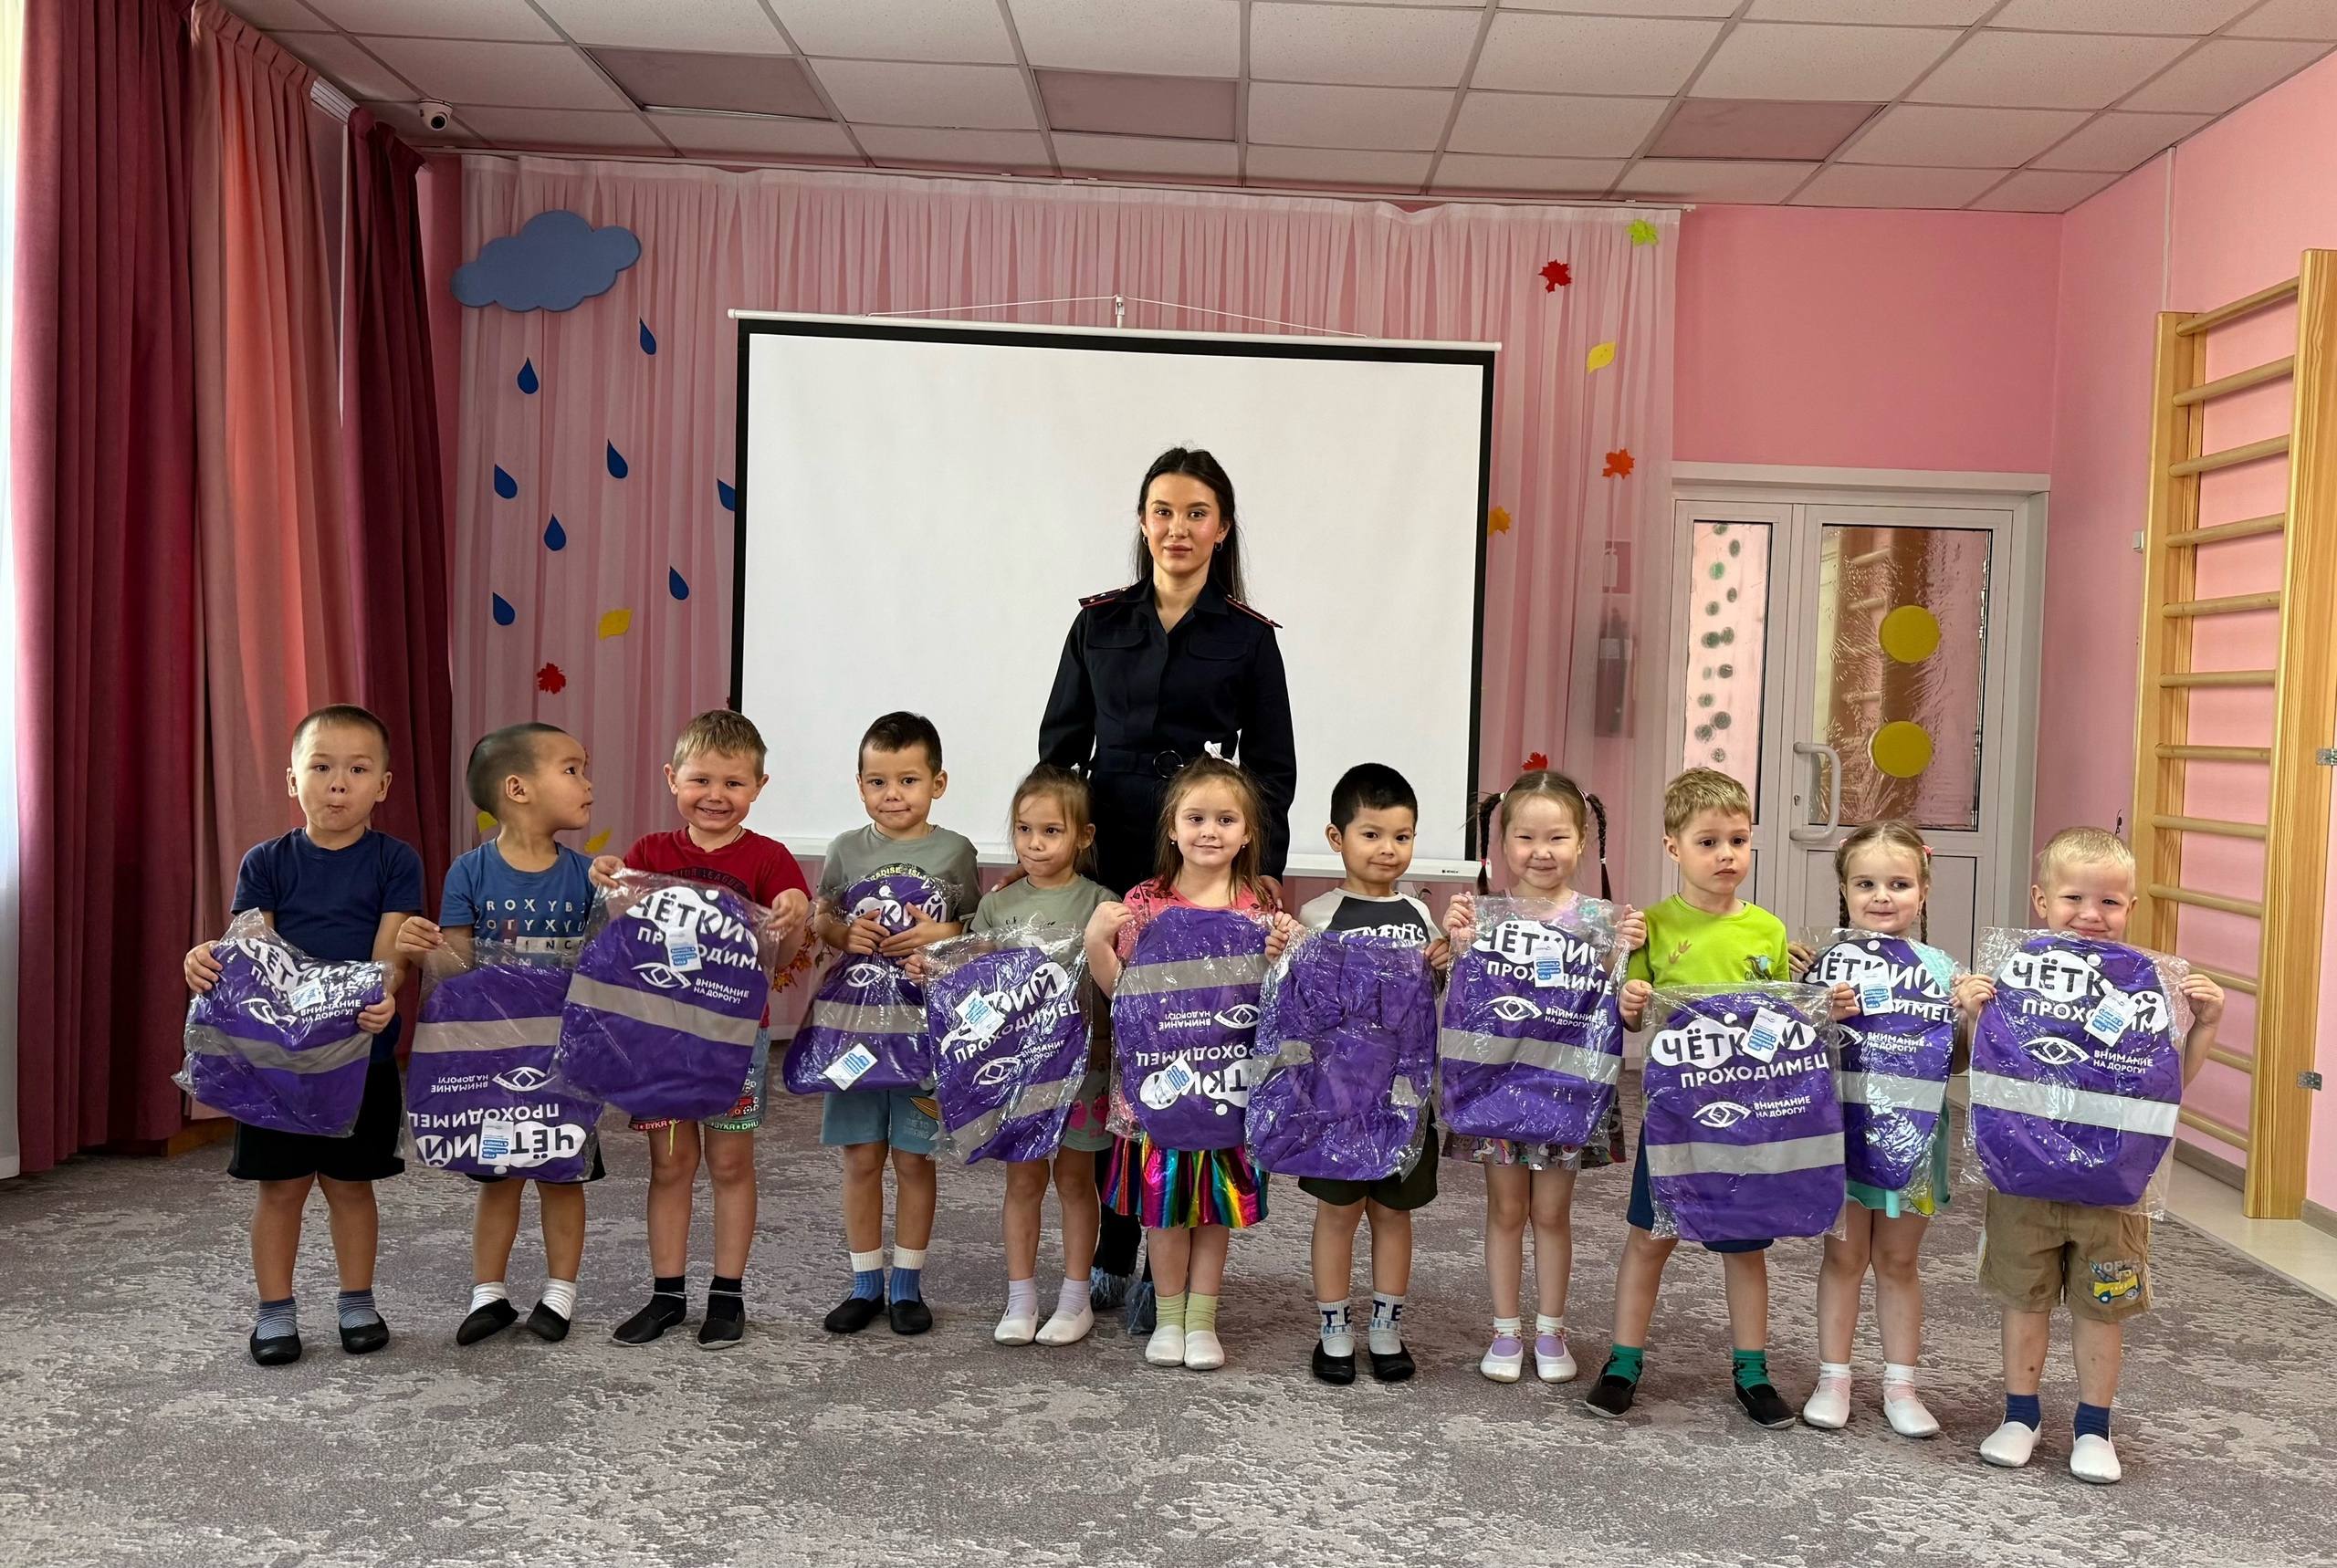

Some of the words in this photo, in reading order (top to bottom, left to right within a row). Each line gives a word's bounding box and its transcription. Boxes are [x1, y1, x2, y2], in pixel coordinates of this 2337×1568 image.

[695, 977, 750, 998] ВНИМАНИЕ
[694, 987, 707, 996] НА
[706, 988, 741, 1005] ДОРОГУ!
[1158, 1019, 1211, 1031] ВНИМАНИЕ
[1556, 1018, 1589, 1028] ДОРОГУ!
[2093, 1050, 2154, 1067] ВНИМАНИЕ
[1681, 1052, 1829, 1089] ПРОХОДИМЕЦ
[2093, 1060, 2106, 1068] НА
[2107, 1061, 2146, 1074] ДОРОГУ!
[430, 1080, 488, 1093] ВНИМАНИЕ
[438, 1075, 475, 1083] ДОРОГУ!
[1754, 1095, 1811, 1111] ВНИМАНИЕ
[1755, 1111, 1769, 1119] НА
[1769, 1106, 1806, 1118] ДОРОГУ!
[424, 1128, 574, 1166] ЧЁТИЙ
